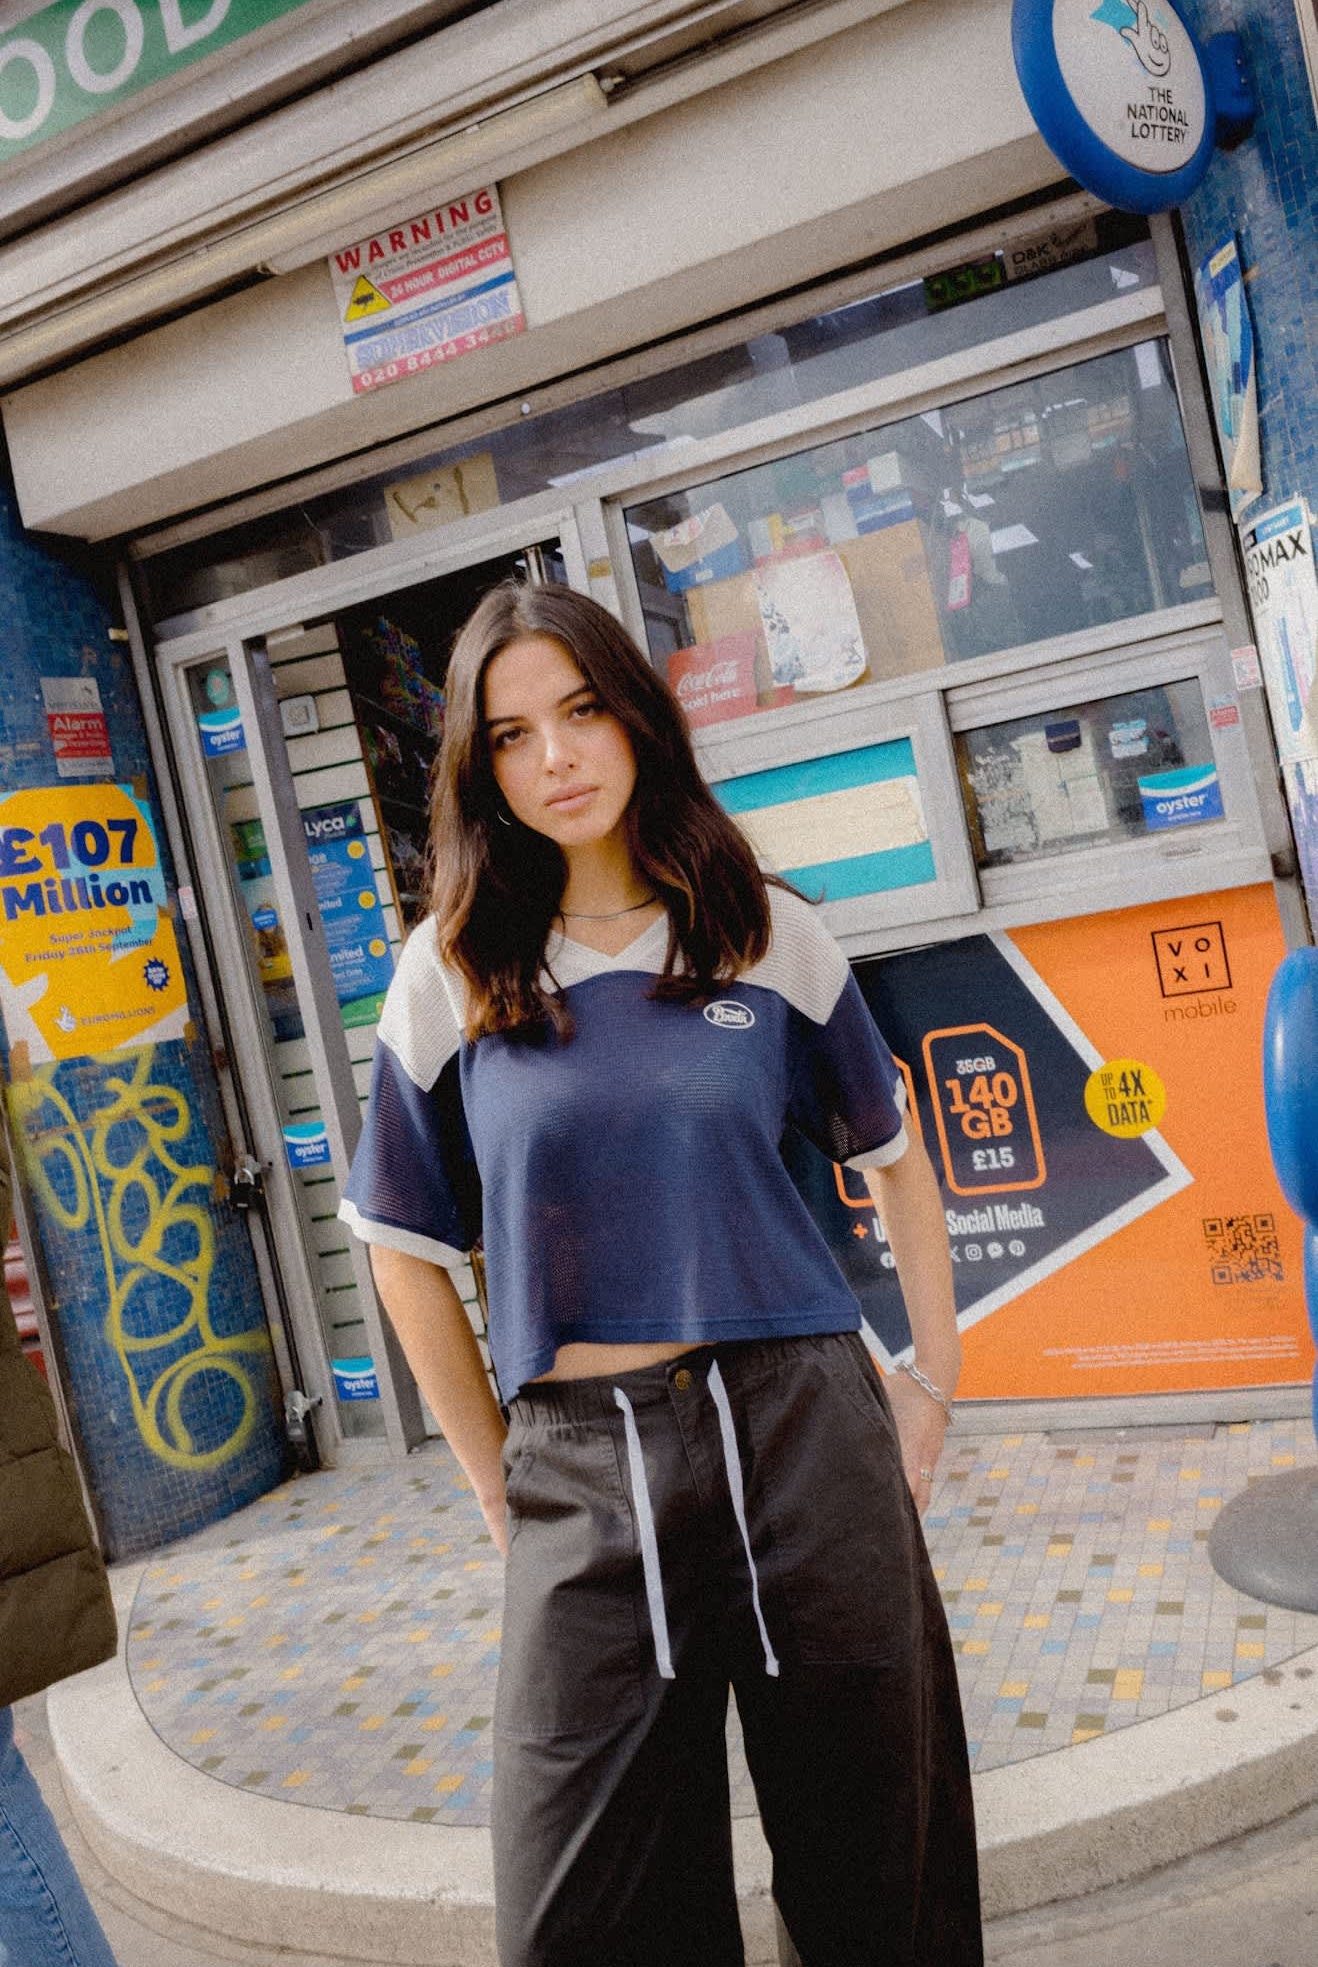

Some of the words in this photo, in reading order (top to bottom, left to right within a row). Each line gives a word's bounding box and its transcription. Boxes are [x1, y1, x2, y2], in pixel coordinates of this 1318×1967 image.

[1147, 86, 1173, 105] THE
[1127, 103, 1189, 127] NATIONAL
[1131, 122, 1187, 145] LOTTERY
[335, 189, 494, 274] WARNING
[389, 283, 405, 298] 24
[403, 271, 435, 291] HOUR
[436, 254, 479, 279] DIGITAL
[477, 240, 507, 260] CCTV
[361, 363, 398, 387] 020
[407, 342, 457, 371] 8444
[54, 716, 104, 731] Alarm
[210, 730, 241, 747] oyster
[1155, 793, 1208, 816] oyster
[304, 816, 345, 837] Lyca
[0, 818, 138, 878] £107
[2, 873, 154, 922] Million
[49, 932, 84, 945] Super
[88, 926, 132, 940] Jackpot
[25, 949, 65, 963] Friday
[98, 937, 153, 952] September
[1164, 995, 1237, 1022] mobile
[944, 1071, 1018, 1114] 140
[1100, 1072, 1113, 1086] UP
[1119, 1069, 1146, 1097] 4X
[1103, 1086, 1117, 1100] TO
[961, 1107, 1014, 1140] GB
[295, 1144, 327, 1158] oyster
[972, 1146, 1015, 1171] £15
[945, 1206, 995, 1236] Social
[995, 1202, 1046, 1230] Media
[343, 1379, 374, 1392] oyster
